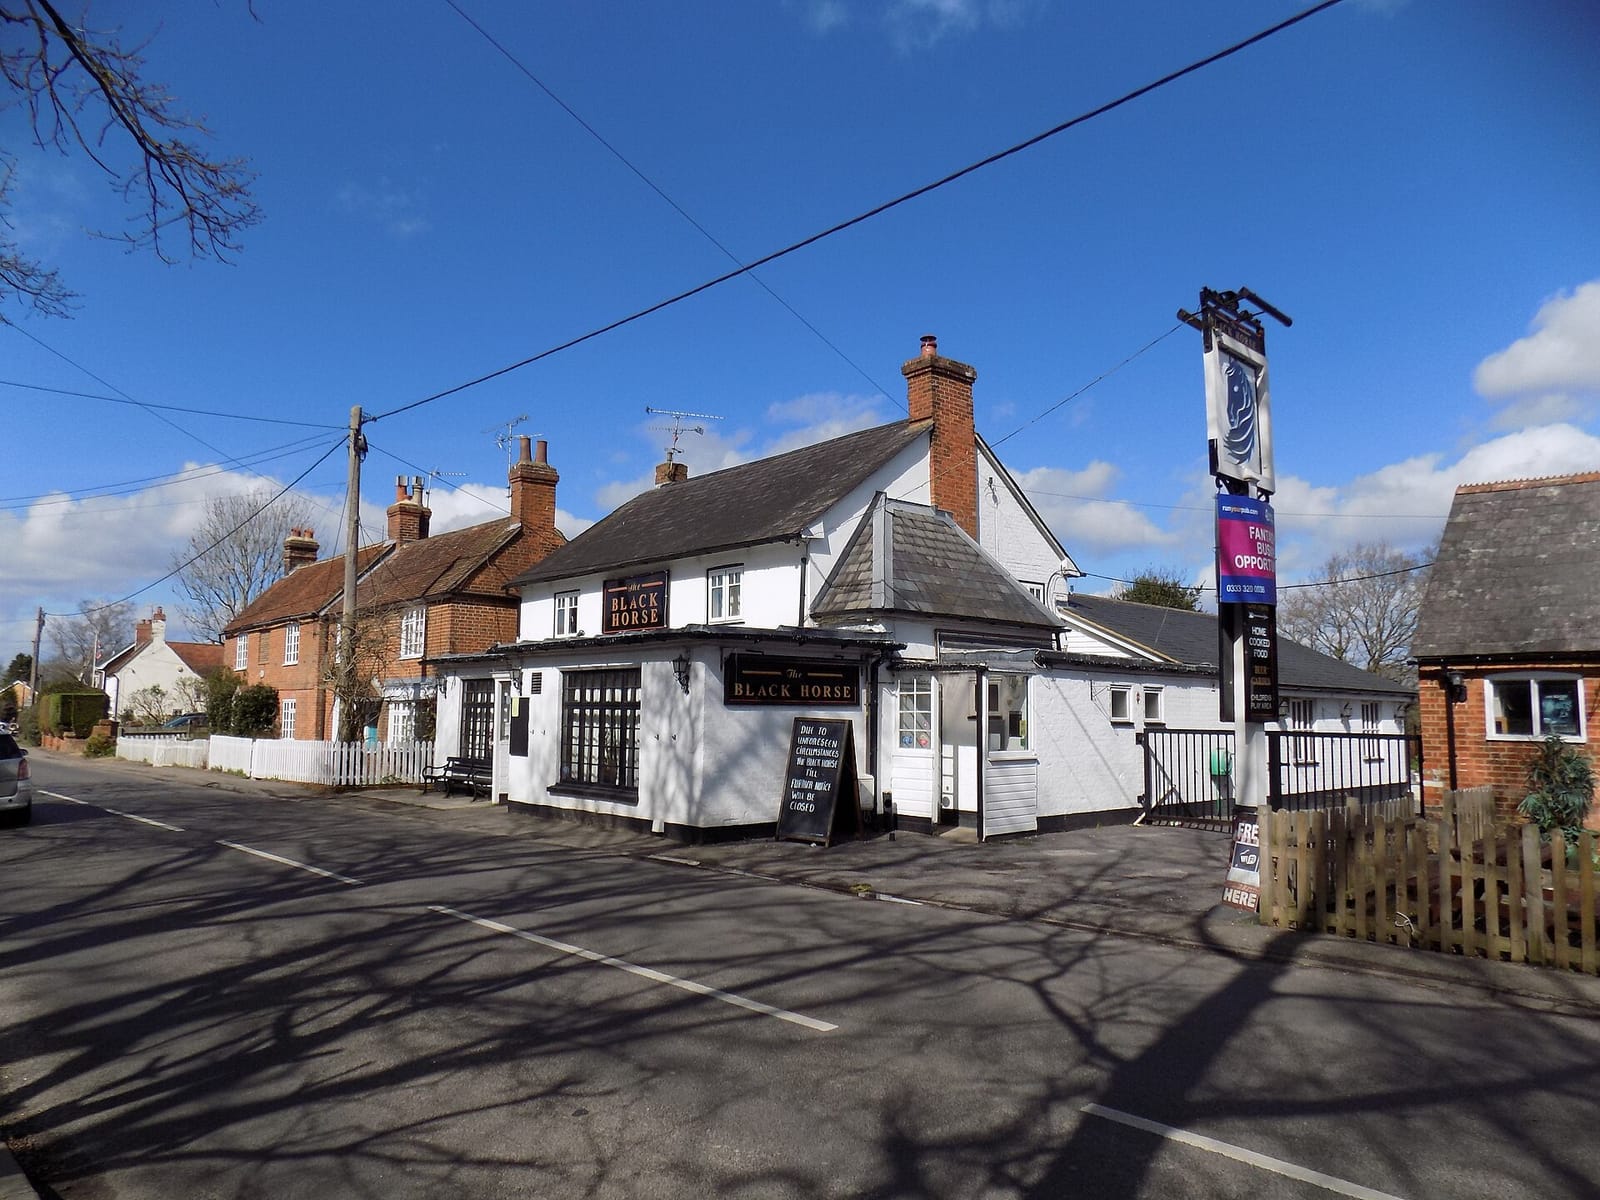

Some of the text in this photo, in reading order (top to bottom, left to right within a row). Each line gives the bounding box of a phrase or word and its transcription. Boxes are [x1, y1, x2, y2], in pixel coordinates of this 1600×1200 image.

[1226, 584, 1241, 593] 0333
[612, 592, 657, 612] BLACK
[612, 609, 658, 627] HORSE
[1252, 626, 1267, 637] HOME
[1249, 638, 1270, 648] COOKED
[1253, 649, 1268, 658] FOOD
[786, 668, 802, 679] The
[734, 683, 851, 698] BLACK HORSE
[800, 725, 827, 736] DUE TO
[797, 736, 838, 748] UNFORESEEN
[806, 792, 816, 801] BE
[789, 801, 816, 813] CLOSED
[1238, 822, 1259, 842] FRE
[1223, 888, 1257, 908] HERE
